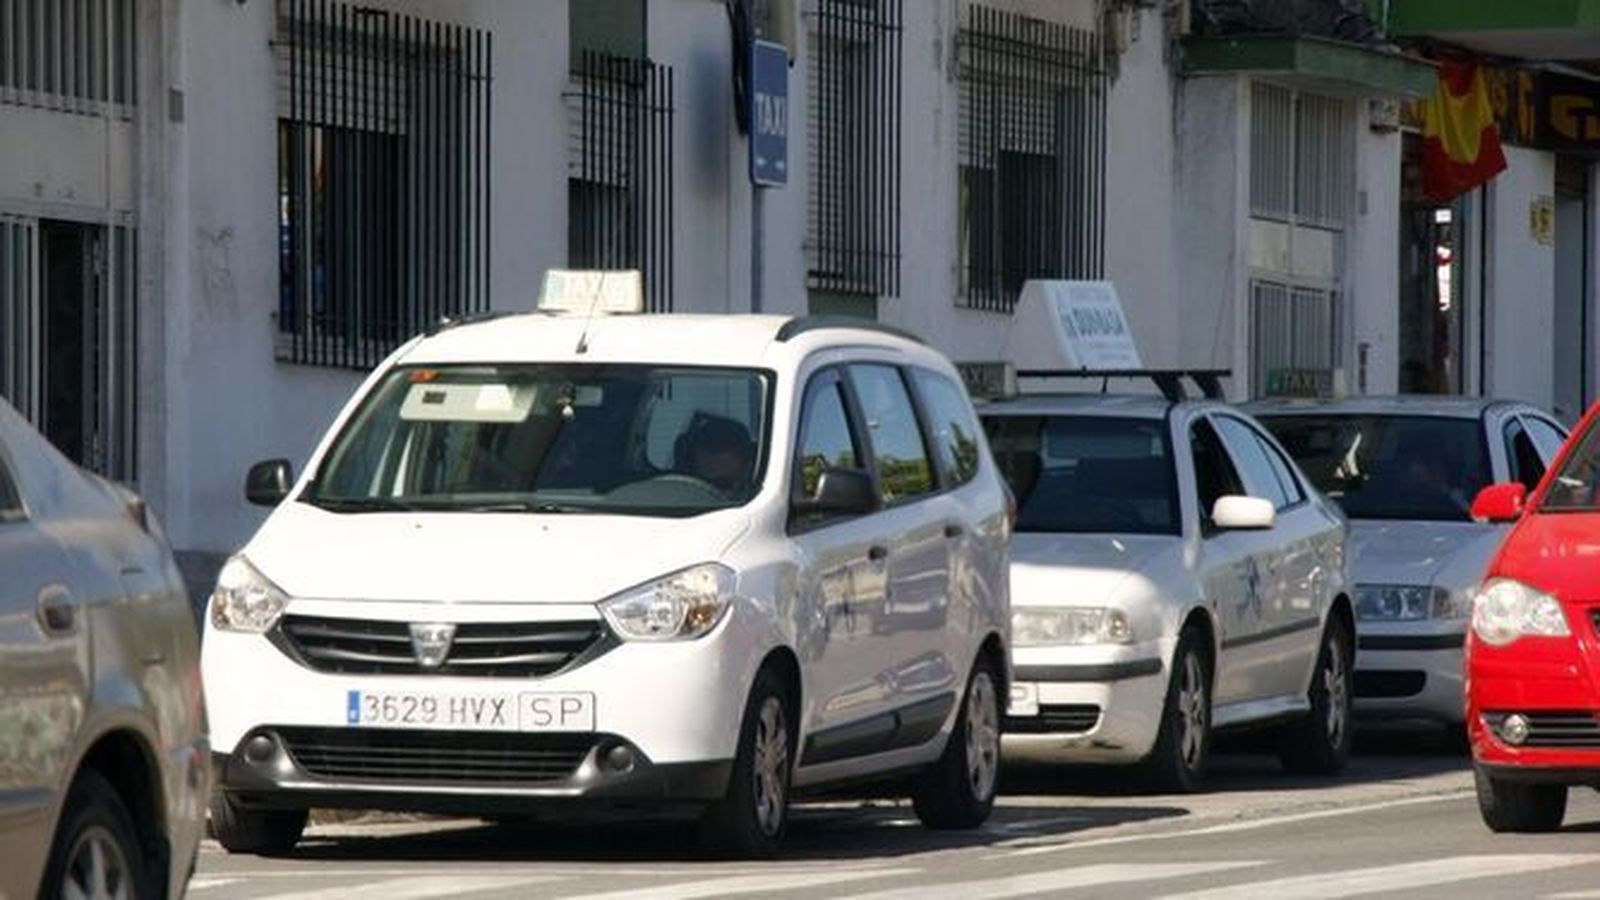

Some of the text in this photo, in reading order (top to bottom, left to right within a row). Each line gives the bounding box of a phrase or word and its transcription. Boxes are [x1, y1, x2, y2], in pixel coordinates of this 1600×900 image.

[755, 91, 786, 136] TAXI
[363, 695, 583, 727] 3629 HVX SP
